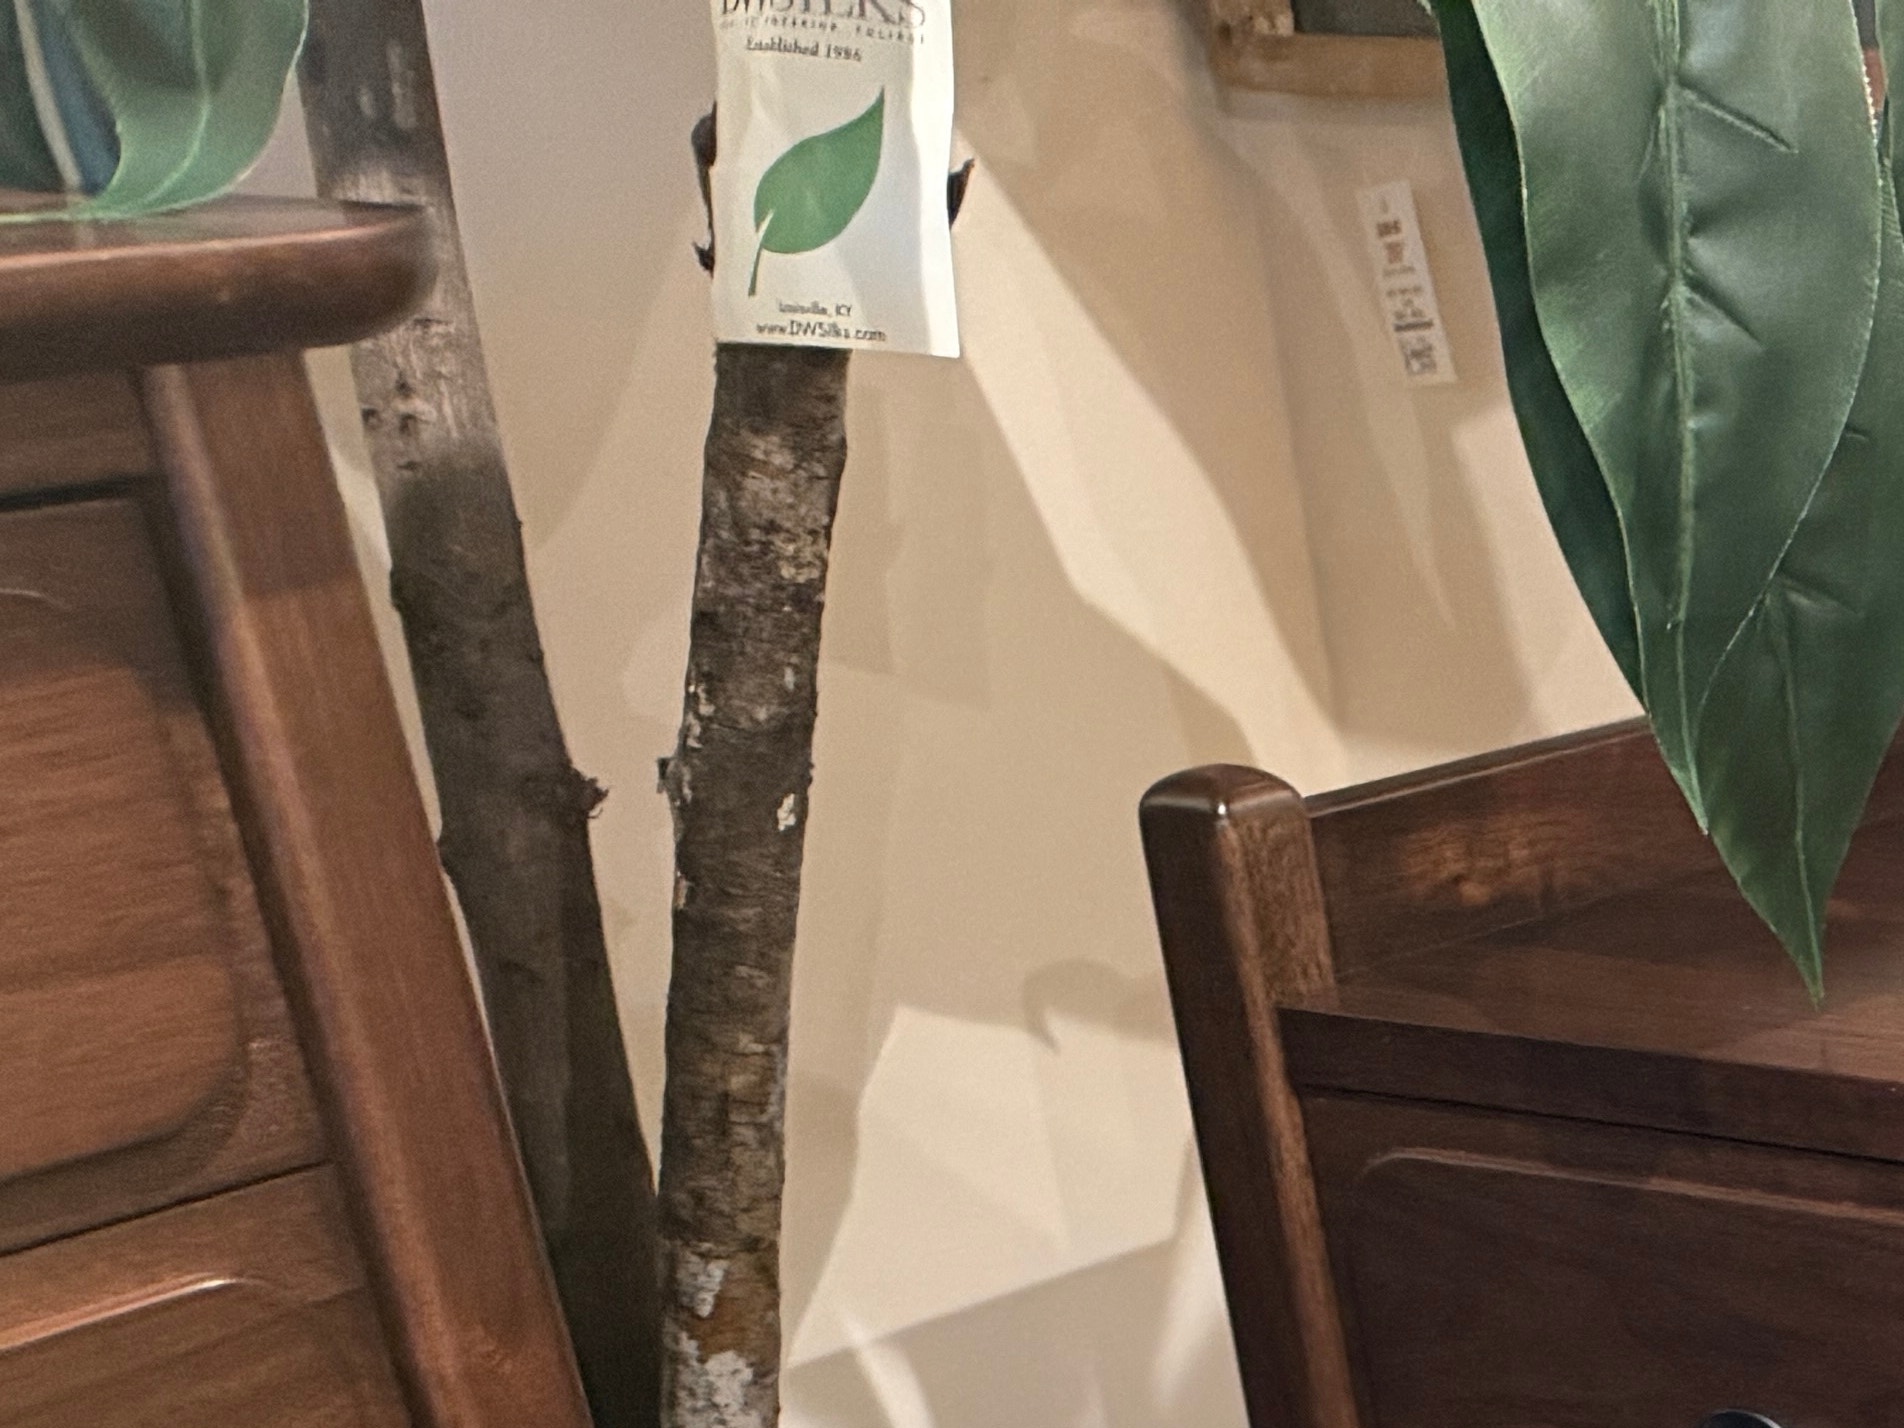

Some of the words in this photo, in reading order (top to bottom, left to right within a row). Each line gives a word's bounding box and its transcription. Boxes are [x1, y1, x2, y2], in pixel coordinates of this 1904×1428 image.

[746, 36, 819, 56] Established
[835, 303, 853, 317] KY
[756, 319, 887, 341] www.DWSilks.com
